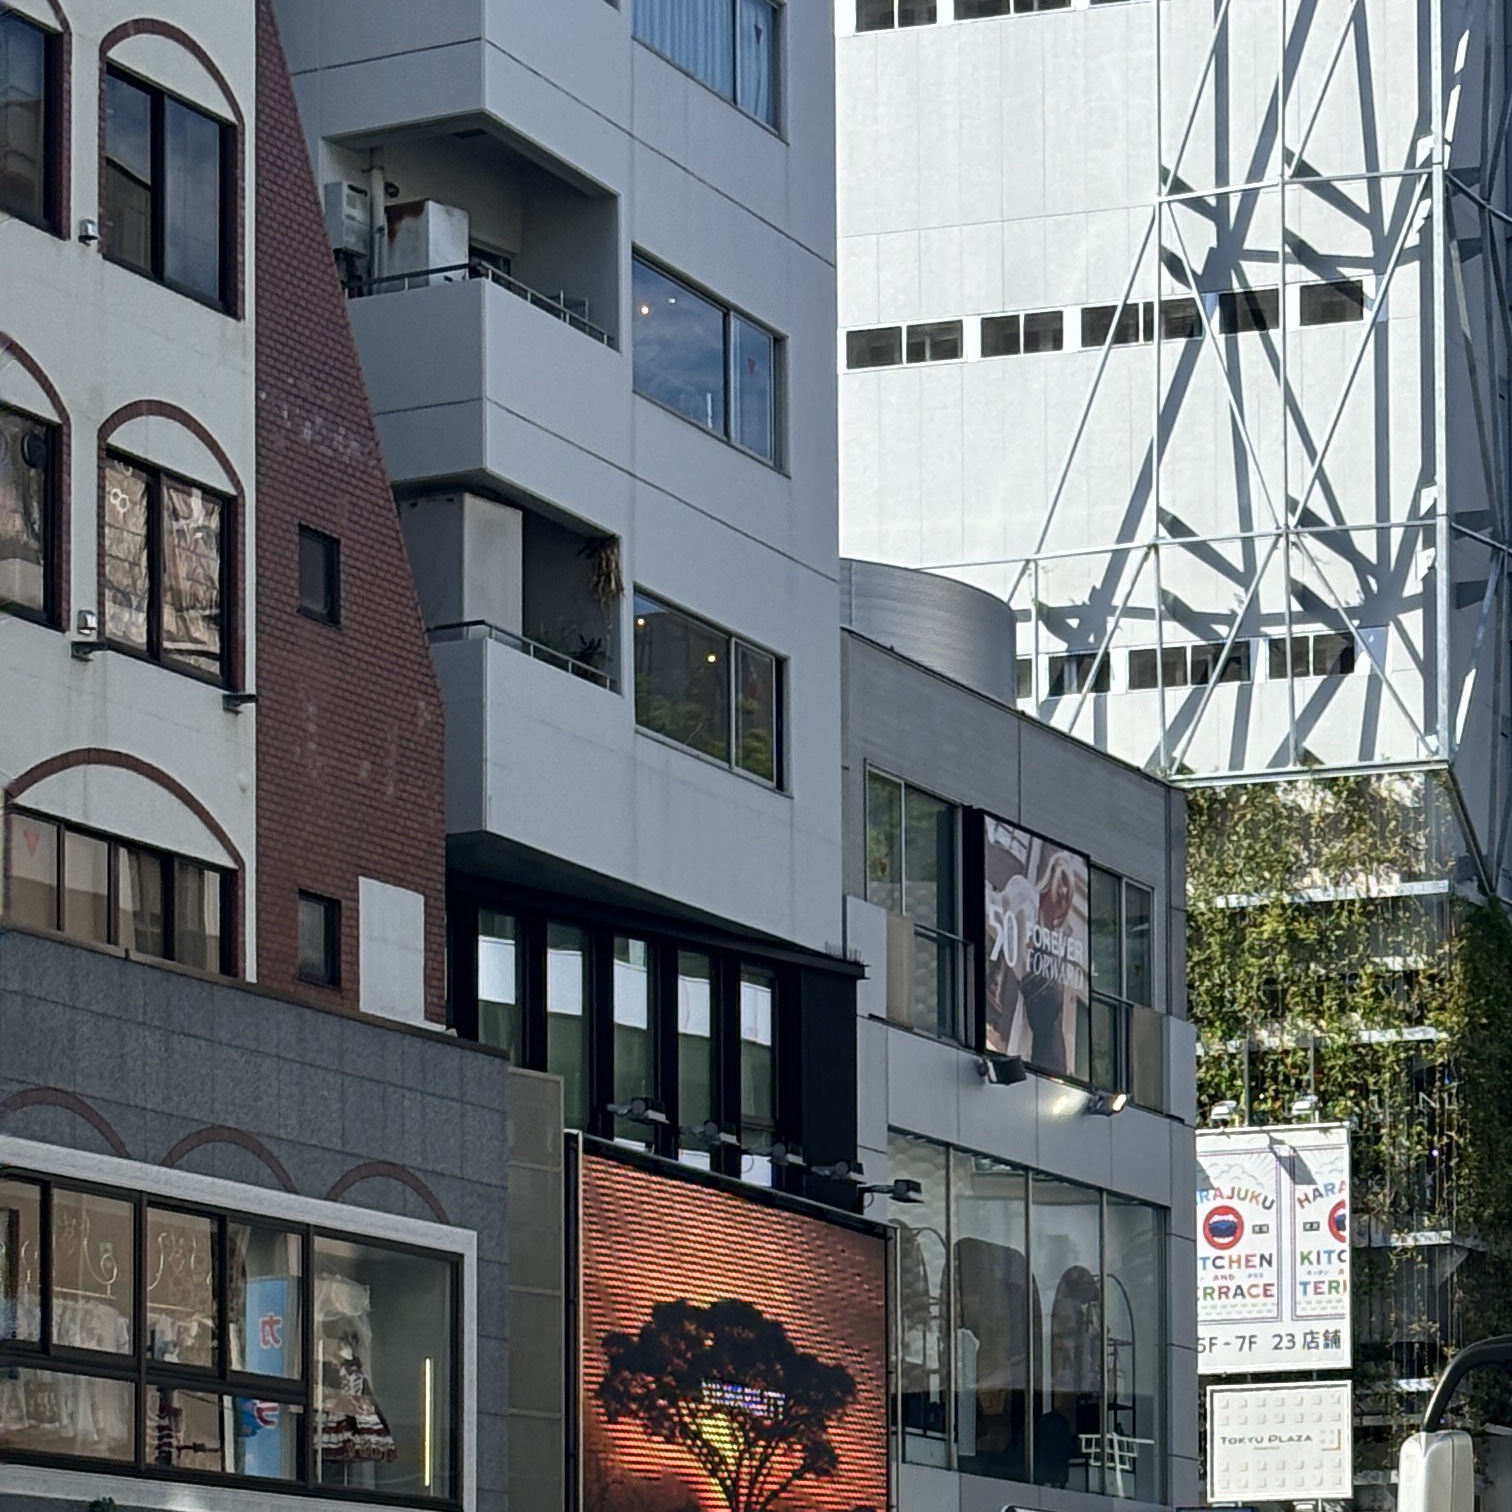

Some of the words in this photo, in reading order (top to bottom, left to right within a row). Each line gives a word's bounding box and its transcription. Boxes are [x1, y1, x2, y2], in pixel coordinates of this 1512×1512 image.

[1025, 920, 1084, 964] FOREVER
[1026, 948, 1085, 990] FORWARD
[1196, 1186, 1275, 1211] RAJUKU
[1197, 1282, 1276, 1301] RRACE
[1220, 1435, 1264, 1446] TOKYU
[1268, 1433, 1313, 1445] PLAZA
